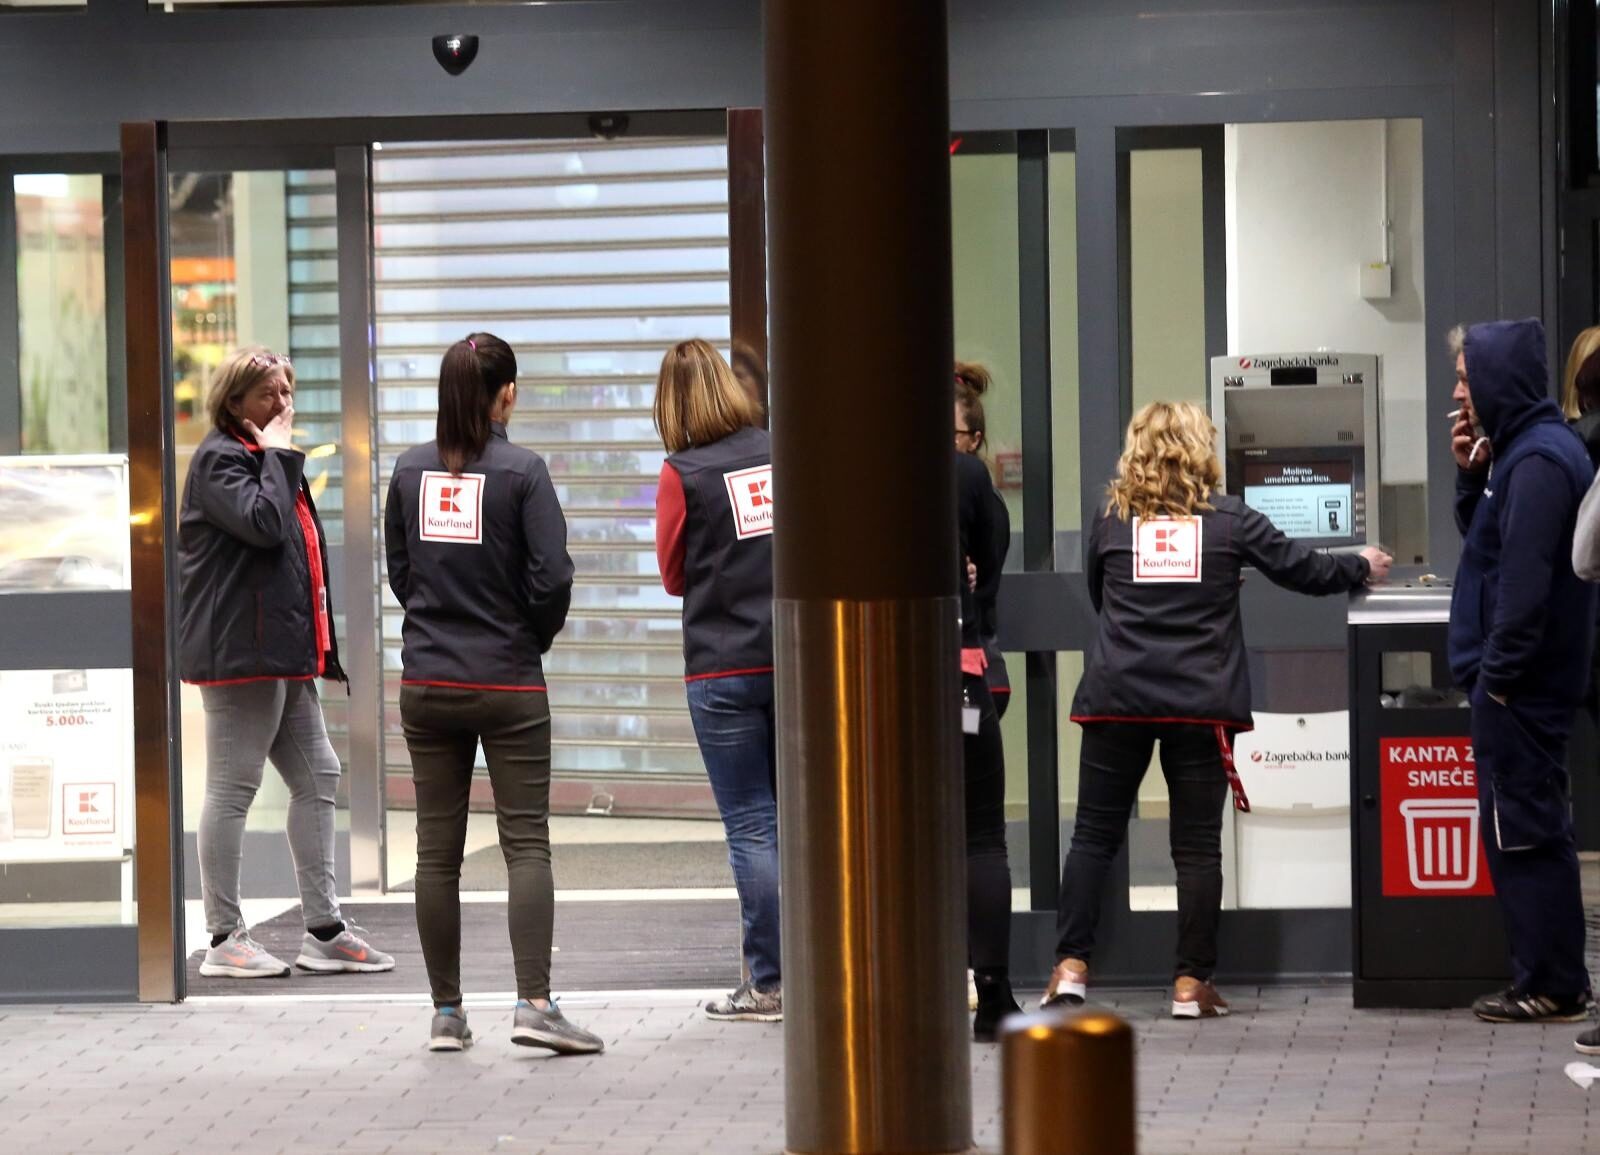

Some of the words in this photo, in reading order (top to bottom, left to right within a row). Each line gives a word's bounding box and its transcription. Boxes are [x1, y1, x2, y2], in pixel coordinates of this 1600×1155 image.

[1309, 355, 1339, 367] banka
[428, 517, 473, 529] Kaufland
[1143, 558, 1191, 568] Kaufland
[1389, 746, 1459, 763] KANTA
[68, 818, 110, 826] Kaufland
